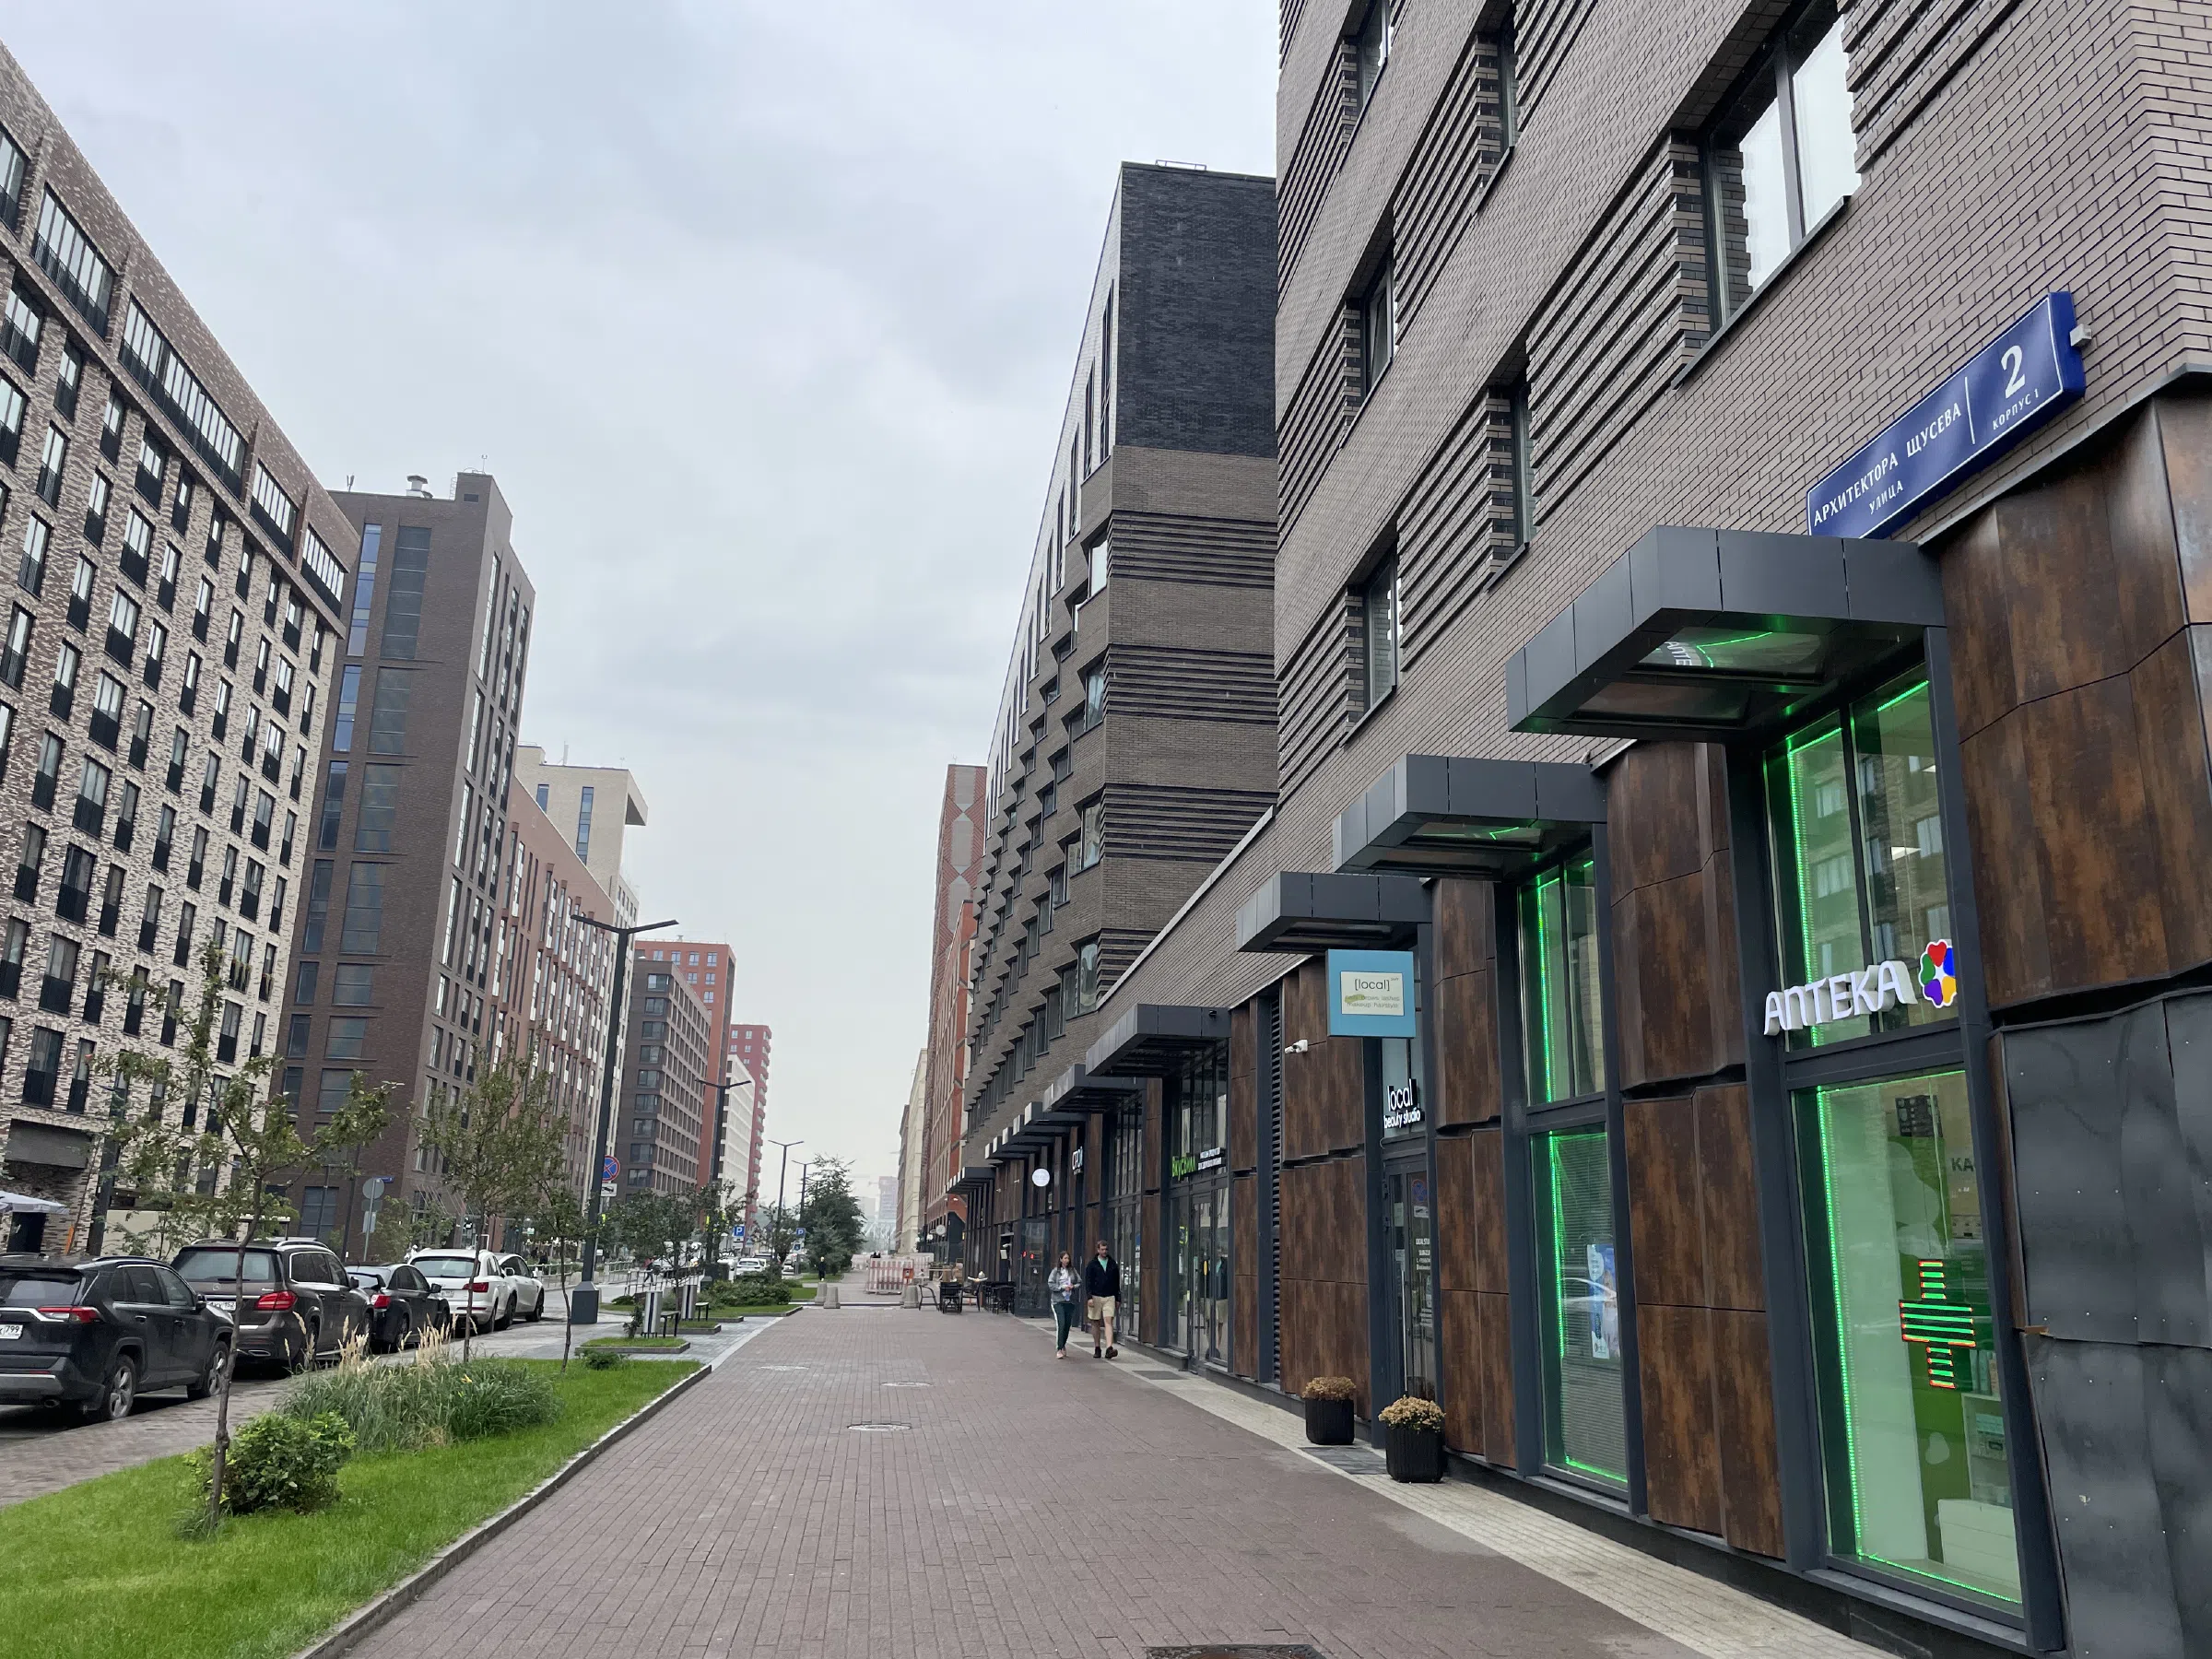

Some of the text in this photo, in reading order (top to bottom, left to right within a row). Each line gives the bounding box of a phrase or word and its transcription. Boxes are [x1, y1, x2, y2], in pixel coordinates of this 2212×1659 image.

[2000, 345, 2026, 398] 2
[1992, 388, 2040, 430] КОРПУС 1
[1814, 403, 1961, 526] АРХИТЕКТОРА ЩУСЕВА
[1868, 480, 1903, 514] УЛИЦА
[1764, 960, 1914, 1035] АПТЕКА
[1387, 1077, 1414, 1112] local
[1383, 1107, 1421, 1129] beauty studio
